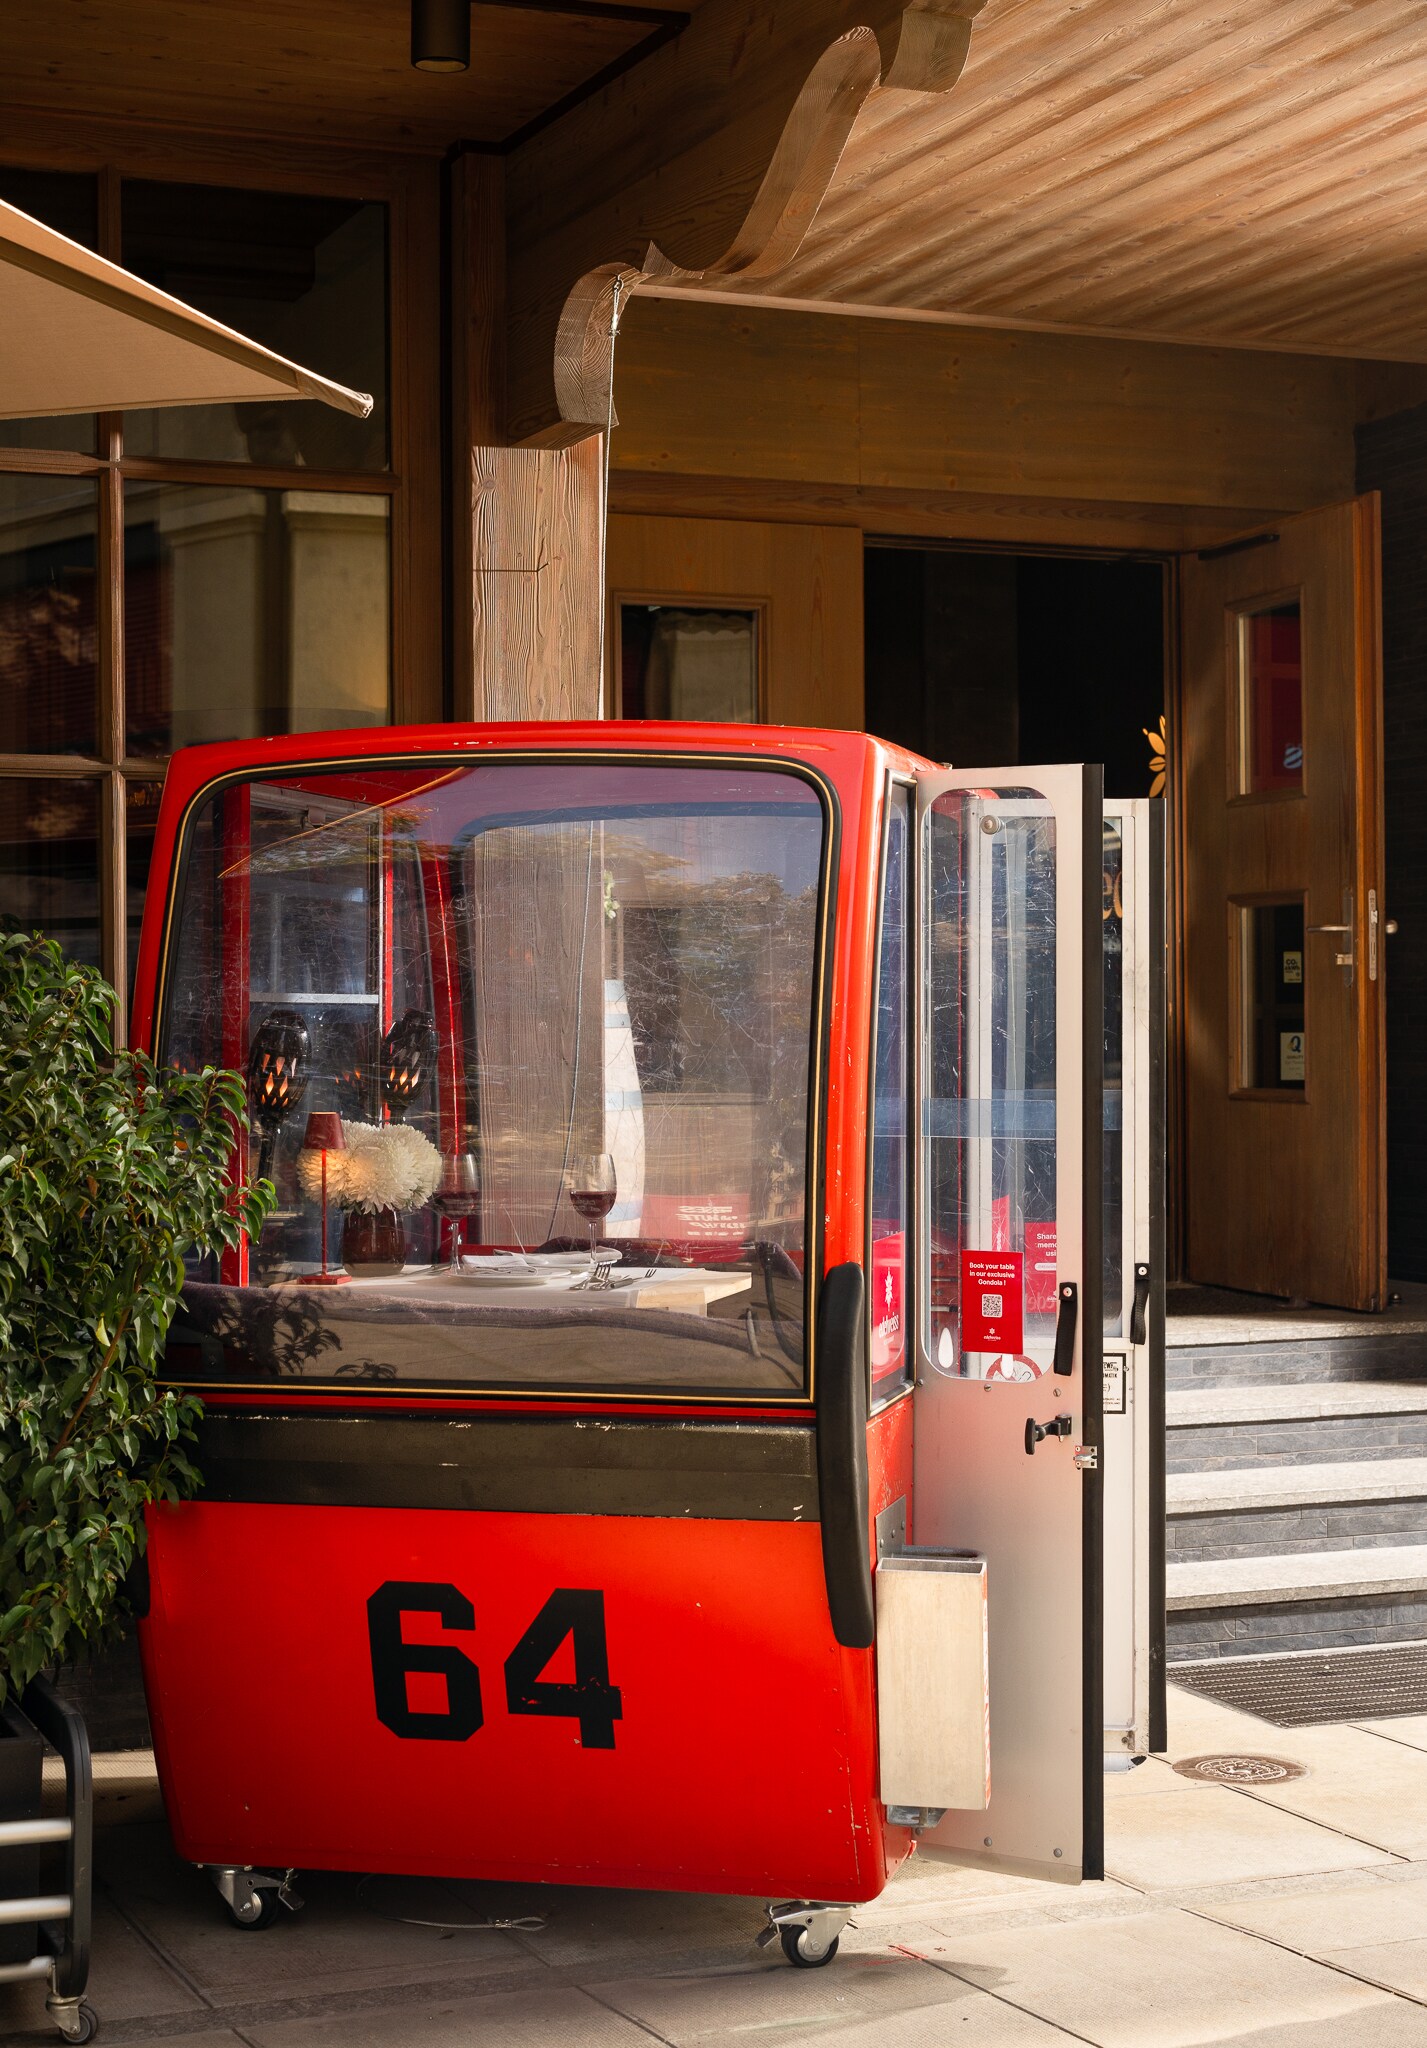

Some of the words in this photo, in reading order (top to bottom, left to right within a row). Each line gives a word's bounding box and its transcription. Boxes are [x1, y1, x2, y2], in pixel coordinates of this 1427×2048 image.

[969, 1262, 985, 1270] Book
[999, 1263, 1015, 1271] table
[986, 1271, 1015, 1279] exclusive
[879, 1312, 899, 1338] edelweiss
[366, 1580, 623, 1750] 64
